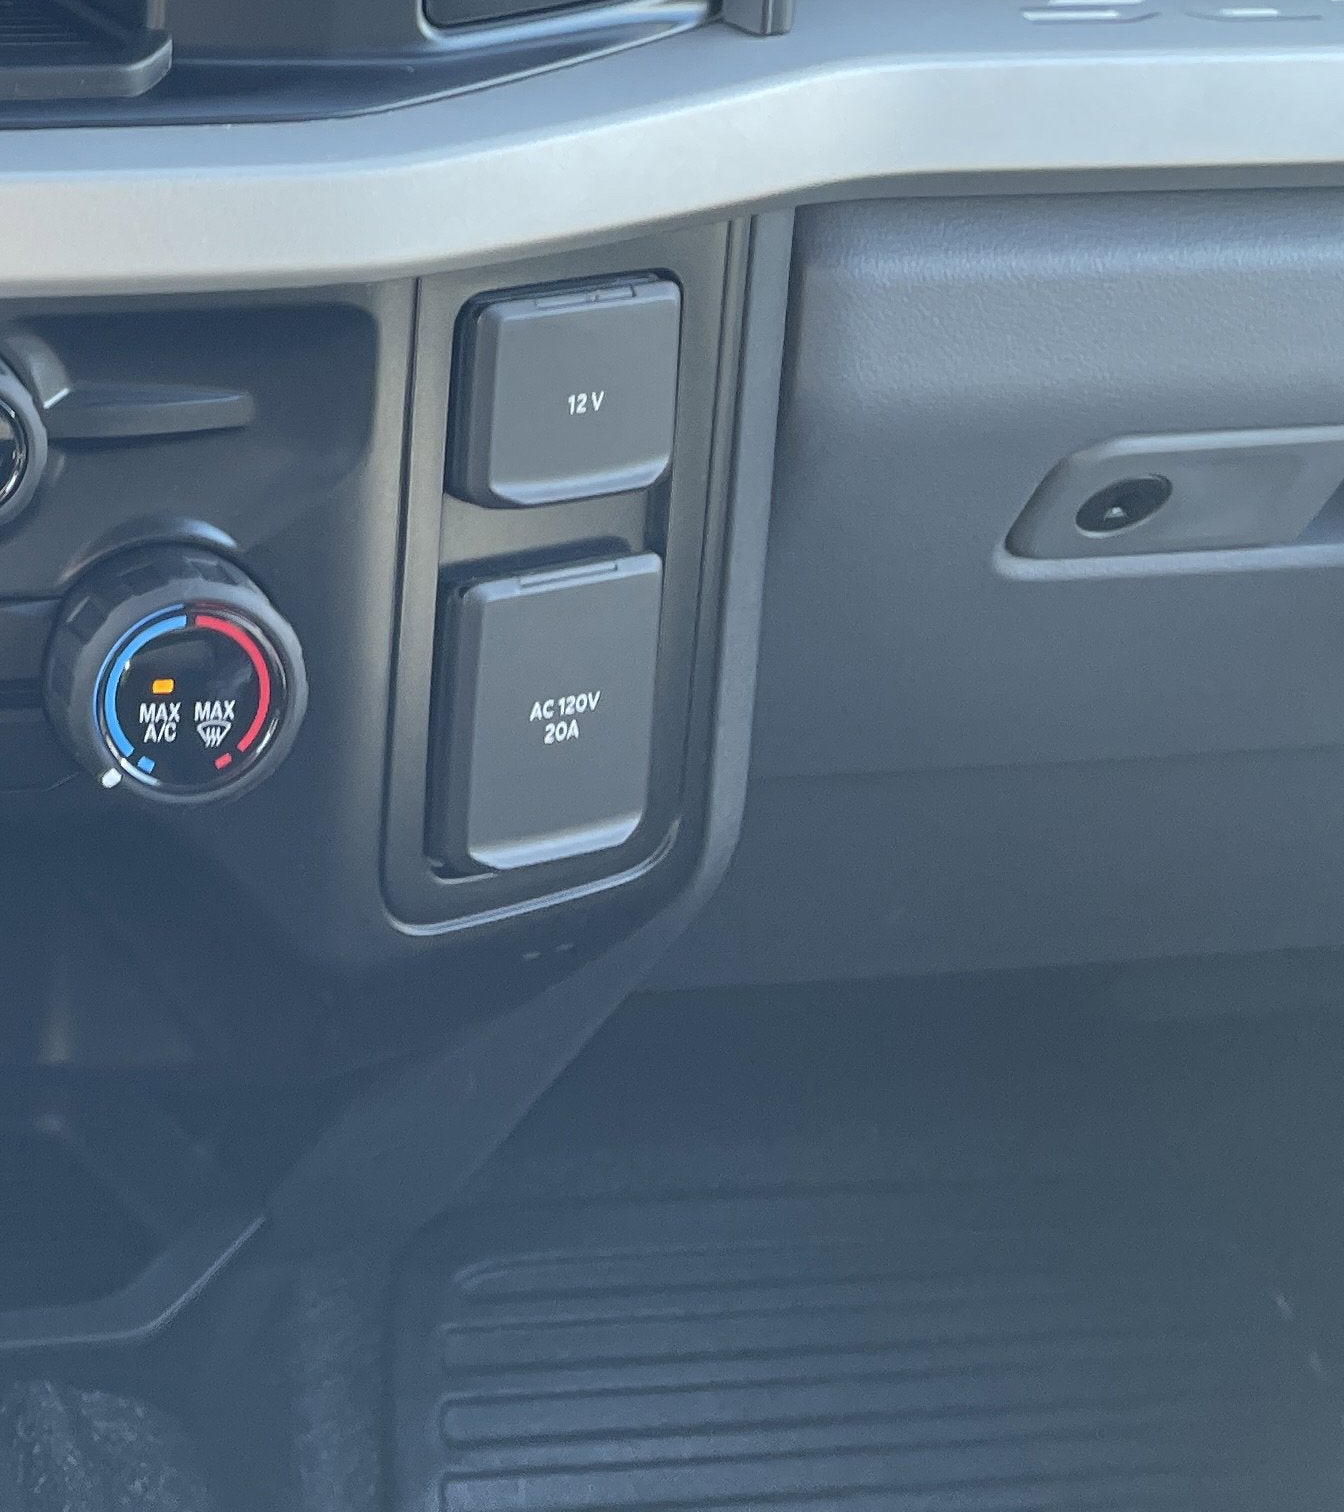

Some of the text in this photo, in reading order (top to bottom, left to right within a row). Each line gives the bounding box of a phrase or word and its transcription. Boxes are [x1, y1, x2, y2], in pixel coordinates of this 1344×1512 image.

[568, 390, 605, 416] 12 V
[139, 701, 181, 724] MAX
[194, 699, 236, 722] MAX
[529, 690, 601, 722] AC 120V
[143, 720, 178, 744] A/C
[544, 719, 580, 745] 20A
